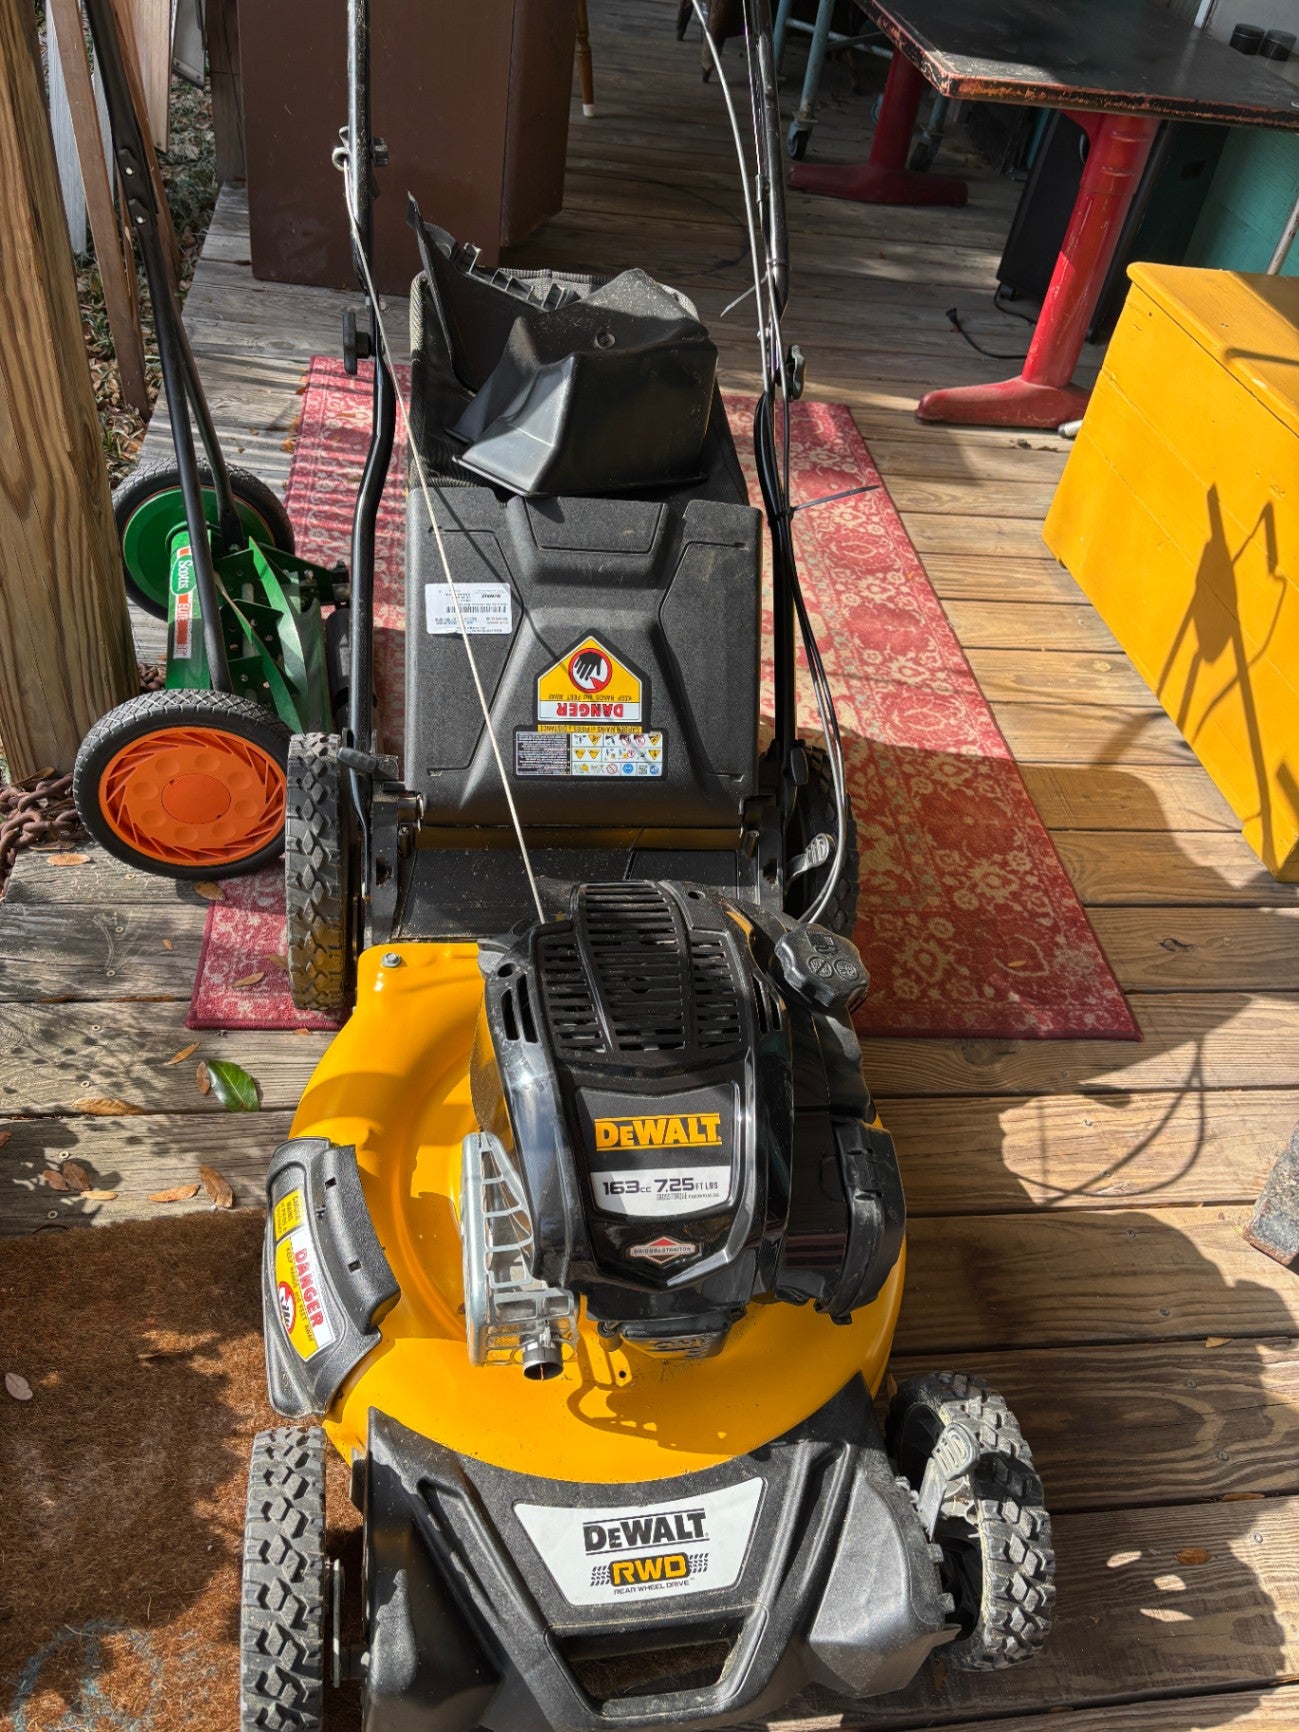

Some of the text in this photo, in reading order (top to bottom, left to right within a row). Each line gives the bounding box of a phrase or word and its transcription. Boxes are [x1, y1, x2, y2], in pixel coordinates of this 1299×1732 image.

[177, 560, 193, 589] Scotts
[556, 702, 624, 718] DANGER
[594, 1114, 721, 1149] DEWALT
[654, 1177, 695, 1193] 7.25
[705, 1181, 718, 1190] LBS
[294, 1247, 324, 1328] DANGER
[583, 1510, 708, 1554] DEWALT
[612, 1554, 686, 1585] RWD
[613, 1579, 690, 1595] REAR WHEEL DRIVE
